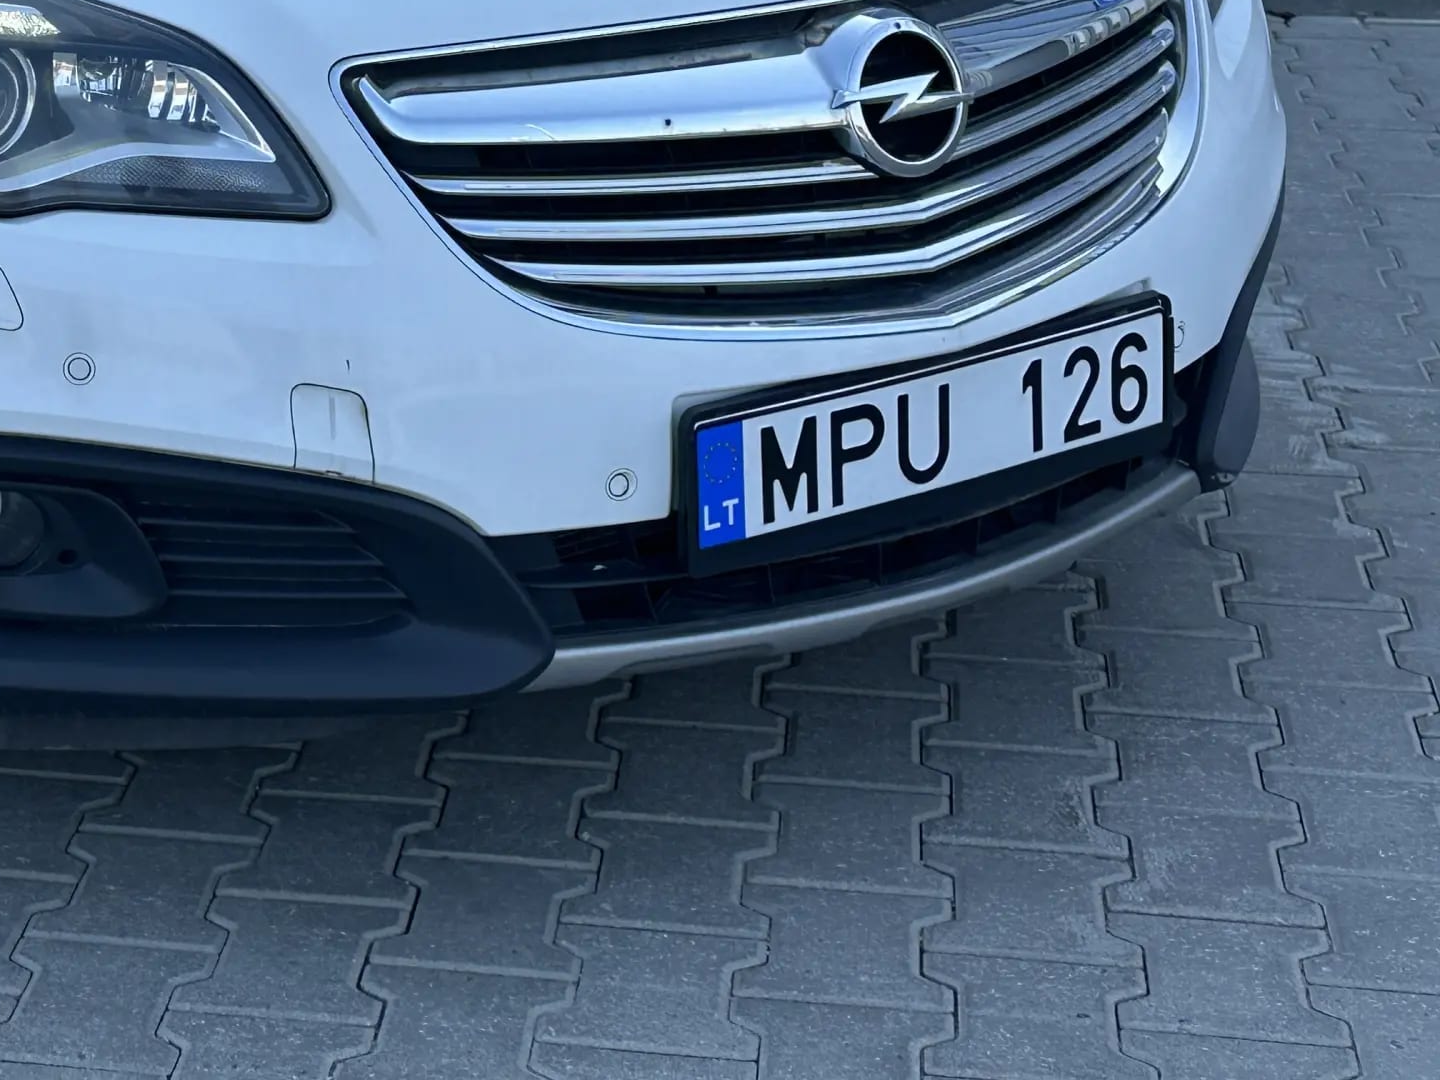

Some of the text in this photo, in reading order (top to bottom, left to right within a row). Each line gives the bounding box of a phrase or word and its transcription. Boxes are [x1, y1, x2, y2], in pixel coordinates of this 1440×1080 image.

[760, 331, 1149, 524] MPU 126
[703, 498, 740, 532] LT
